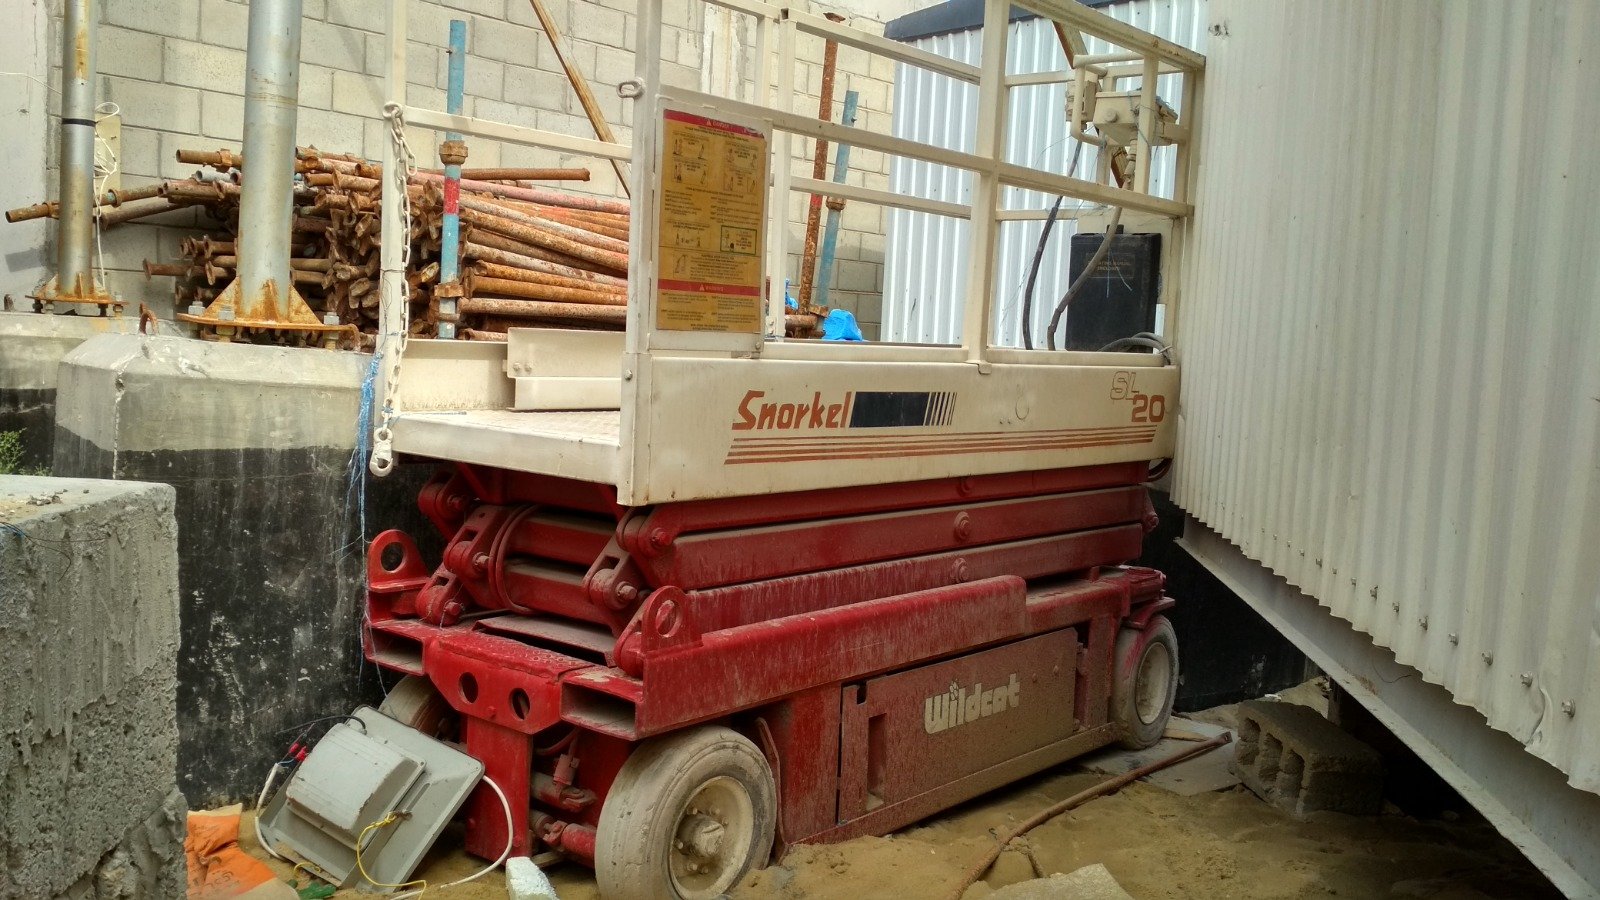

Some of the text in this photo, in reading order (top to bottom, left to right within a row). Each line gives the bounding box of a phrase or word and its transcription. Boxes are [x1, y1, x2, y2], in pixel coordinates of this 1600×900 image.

[1110, 370, 1139, 400] SL
[731, 389, 852, 430] Snorkel
[1131, 394, 1165, 422] 20
[924, 673, 1020, 735] Wildcat
